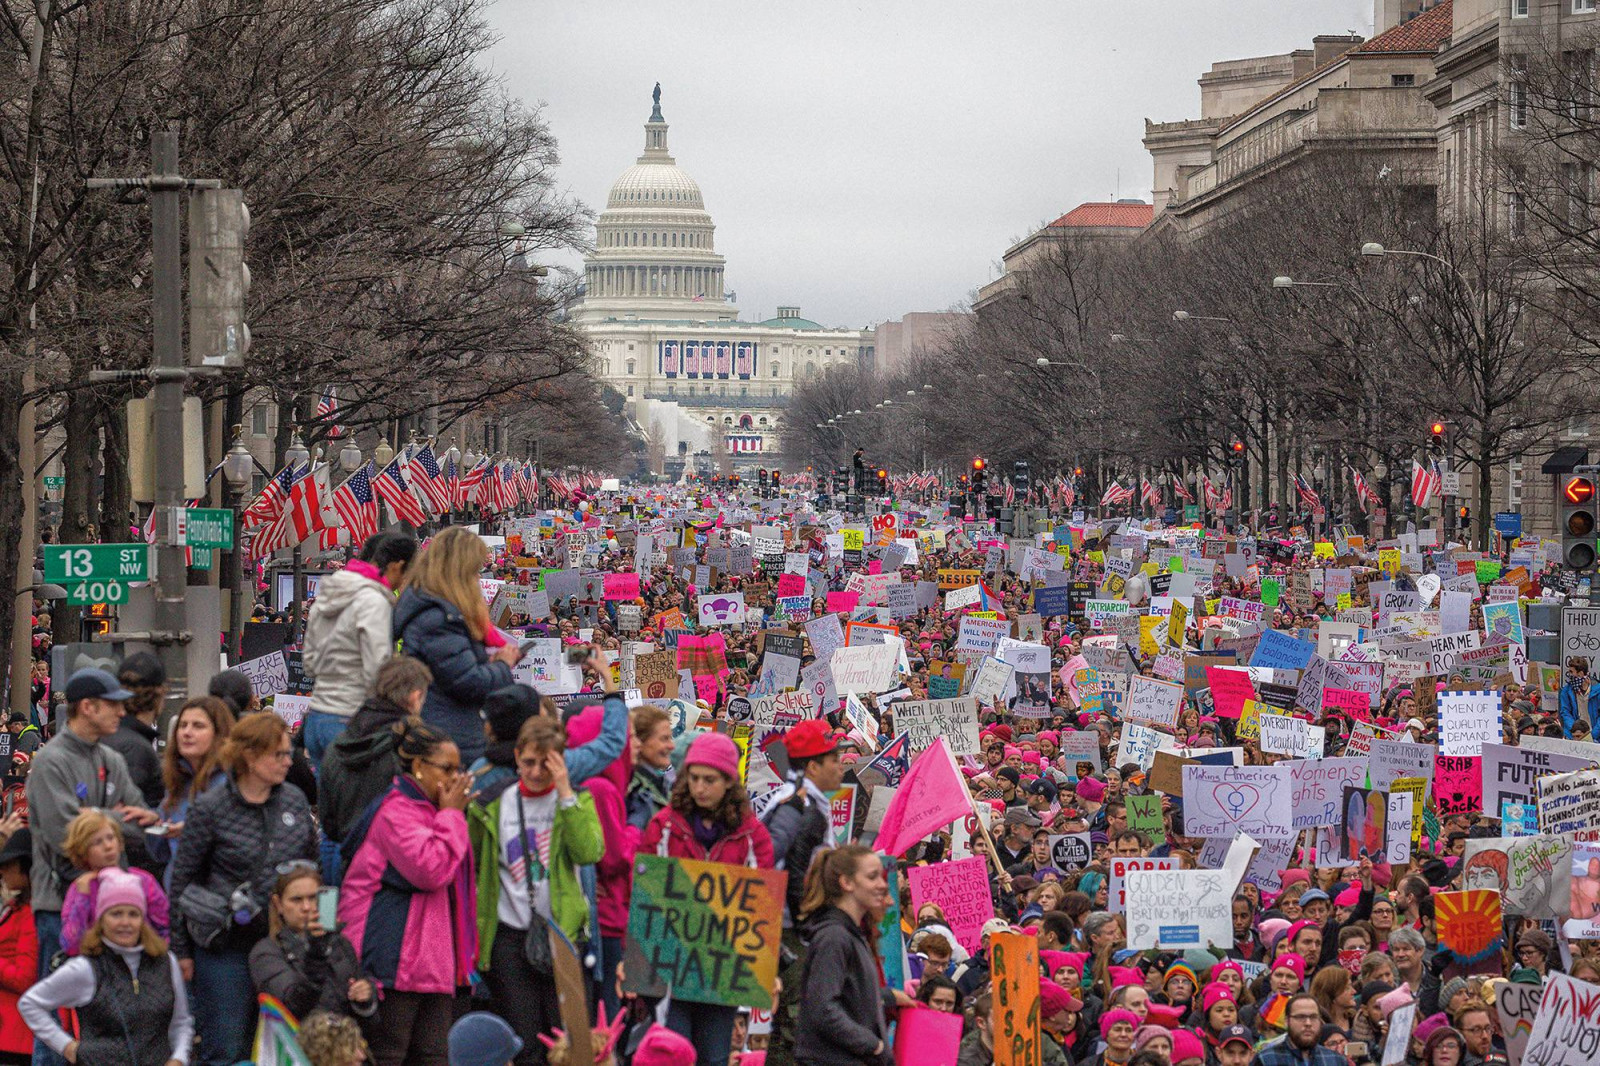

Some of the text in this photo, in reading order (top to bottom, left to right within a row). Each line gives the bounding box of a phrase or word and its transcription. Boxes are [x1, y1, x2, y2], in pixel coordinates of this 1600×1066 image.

[873, 514, 896, 531] HO
[844, 532, 860, 541] ONE
[59, 549, 139, 577] 13 ST
[195, 549, 209, 566] 1300
[121, 563, 141, 575] NW
[938, 574, 980, 585] RESIST
[1356, 573, 1382, 585] LOVE
[73, 582, 122, 602] 400
[1086, 601, 1129, 612] PATRIARCHY
[1222, 597, 1264, 612] WE ARE
[1229, 607, 1257, 621] BETTER
[1567, 613, 1597, 626] THRU
[965, 619, 1006, 630] AMERICANS
[964, 629, 980, 637] WILL
[981, 630, 994, 638] NOT
[774, 637, 794, 648] HATE
[966, 639, 990, 648] RULED
[1268, 633, 1301, 652] checks
[1431, 634, 1473, 653] HEAR ME
[636, 654, 666, 663] RESPETA
[1105, 650, 1128, 668] SHE
[1262, 645, 1303, 666] balances
[1461, 647, 1500, 662] WOMEN
[1515, 647, 1524, 657] A
[258, 653, 283, 670] ARE
[1388, 661, 1399, 669] We
[803, 670, 813, 679] OUR
[818, 669, 828, 678] NOT
[1345, 663, 1383, 677] YOUR TINY
[251, 673, 268, 684] THE
[251, 675, 289, 695] TORM
[1354, 681, 1381, 693] OFF MY
[278, 701, 295, 710] HEAR
[1326, 691, 1366, 706] ETHICS
[895, 704, 925, 719] WHEN
[929, 703, 945, 716] DID
[1447, 703, 1489, 714] MEN OF
[896, 715, 949, 727] DOLLAR
[1261, 718, 1304, 734] DIVERSITY IS
[1447, 719, 1490, 731] QUALITY
[1267, 731, 1309, 753] beautiful
[1352, 730, 1372, 742] DON'T
[1447, 732, 1490, 742] DEMAND
[1379, 744, 1429, 759] STOP TRYING
[1448, 744, 1482, 755] WOME
[1388, 757, 1415, 767] CONTROL
[1436, 755, 1473, 772] GRAB
[1521, 750, 1550, 766] THE
[1189, 767, 1281, 781] Making America
[1292, 781, 1326, 808] ghts
[1543, 786, 1554, 797] AM
[1558, 783, 1571, 793] NO
[1573, 777, 1598, 789] LONGER
[1132, 800, 1157, 819] We
[1542, 795, 1581, 813] ACCEPTING
[1547, 808, 1575, 825] CANNOT
[1186, 818, 1230, 834] GREAT
[1263, 825, 1289, 835] 1776
[1554, 820, 1588, 834] CHANGING
[1062, 837, 1077, 847] END
[930, 861, 981, 876] THE TRUE
[921, 870, 985, 889] GREATNESS
[1128, 873, 1186, 892] GOLDEN
[665, 863, 765, 914] LOVE
[921, 880, 985, 899] OF A NATION
[975, 891, 988, 902] ON
[1130, 890, 1192, 909] SHOWERS
[975, 902, 986, 912] OF
[1131, 906, 1169, 921] BRING
[637, 903, 771, 952] TRUMPS
[1449, 922, 1486, 938] RISE
[652, 945, 758, 994] HATE
[1243, 961, 1261, 976] THIS
[1501, 986, 1543, 1020] CAS
